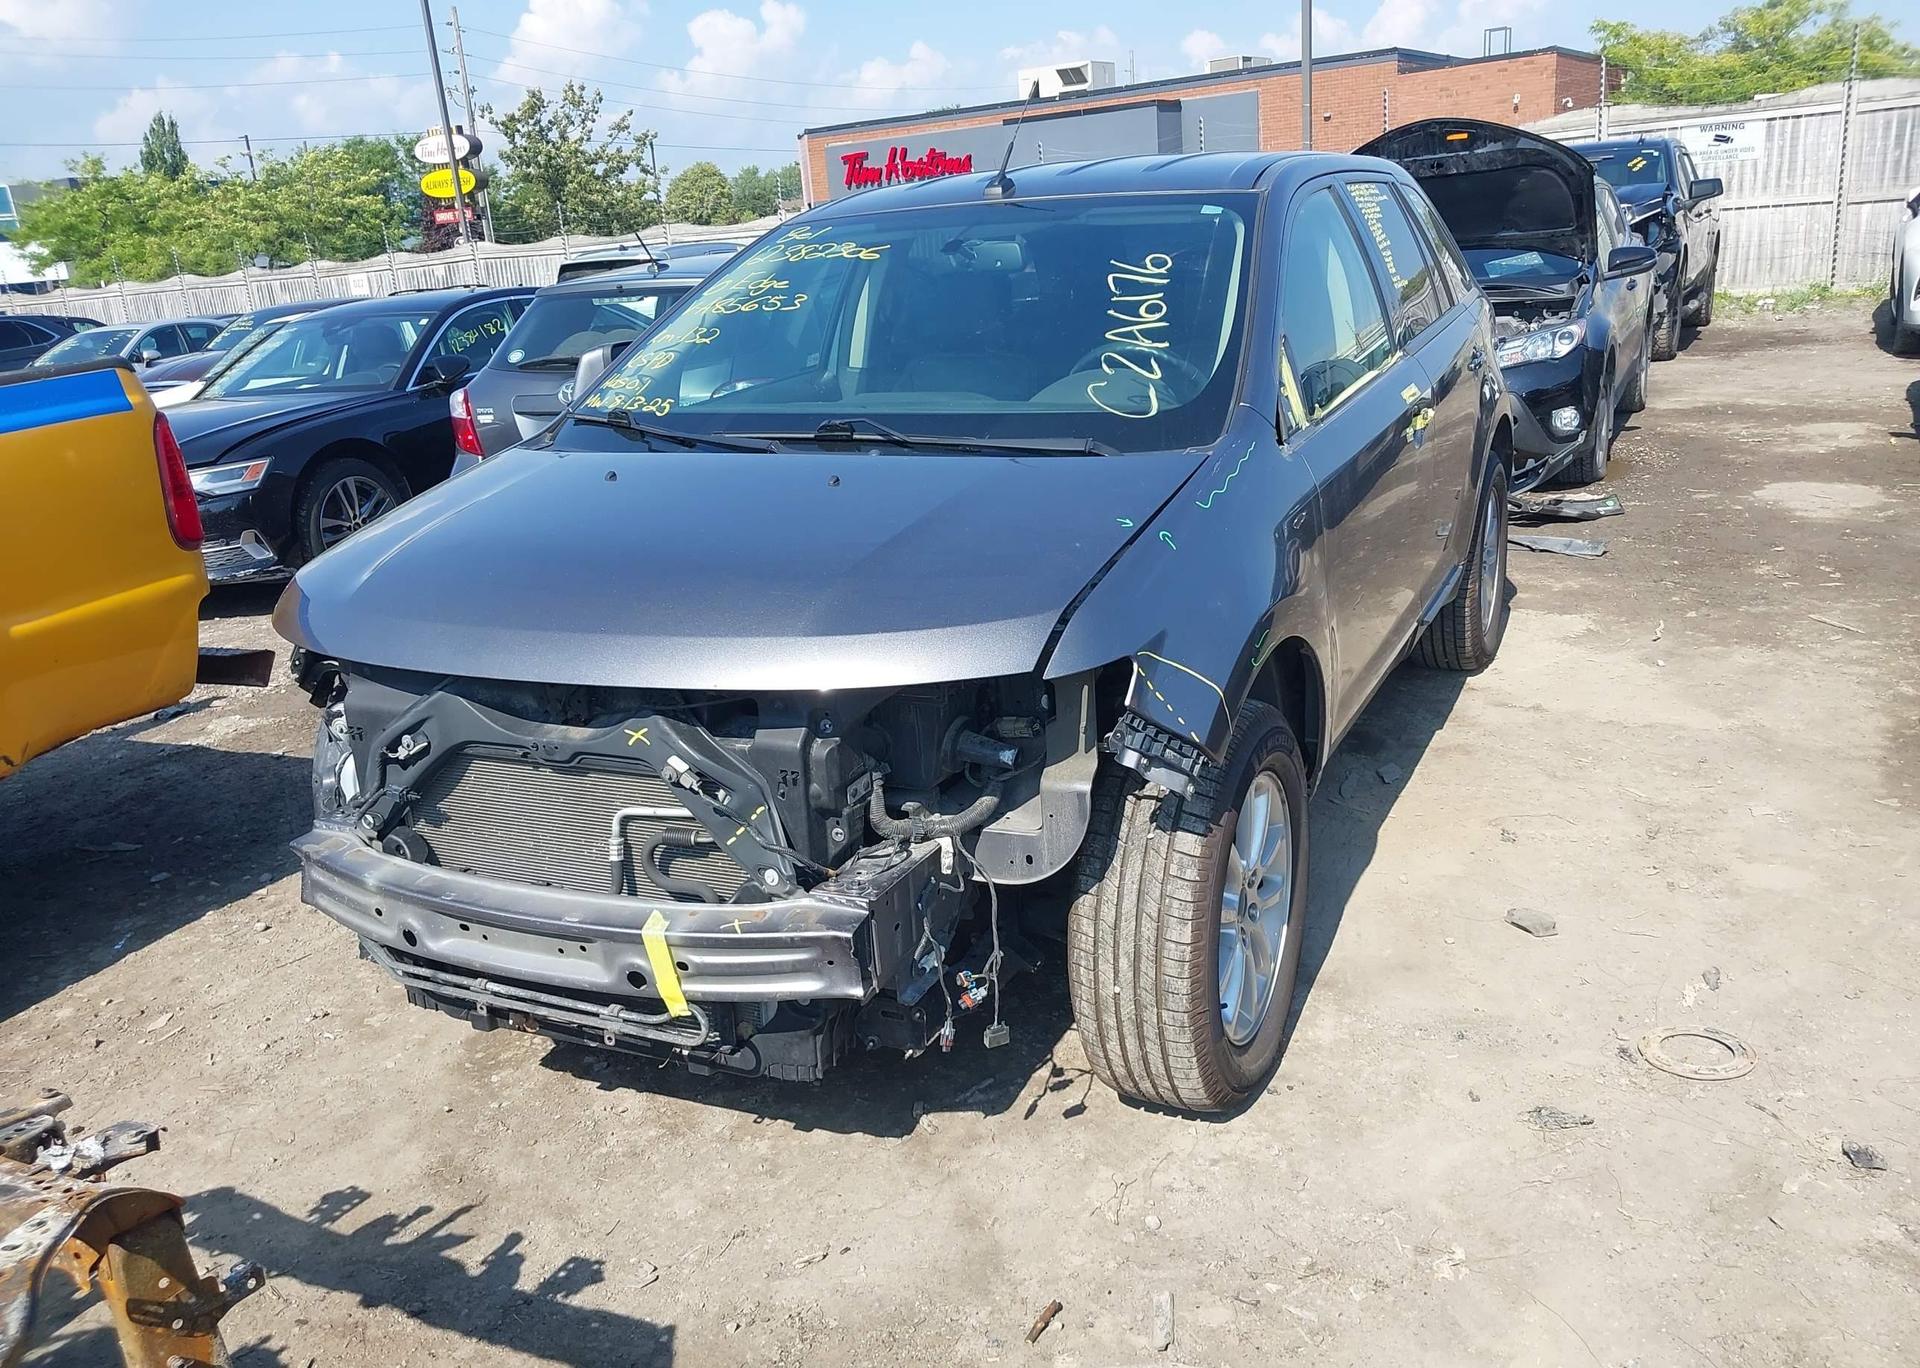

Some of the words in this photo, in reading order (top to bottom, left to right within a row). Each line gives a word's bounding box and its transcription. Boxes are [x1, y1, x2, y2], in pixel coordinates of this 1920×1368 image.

[1700, 122, 1745, 133] WARNING
[841, 150, 882, 189] Tim
[885, 146, 972, 182] Hortons
[425, 179, 449, 191] ALWAYS
[1087, 253, 1173, 418] C2A6176
